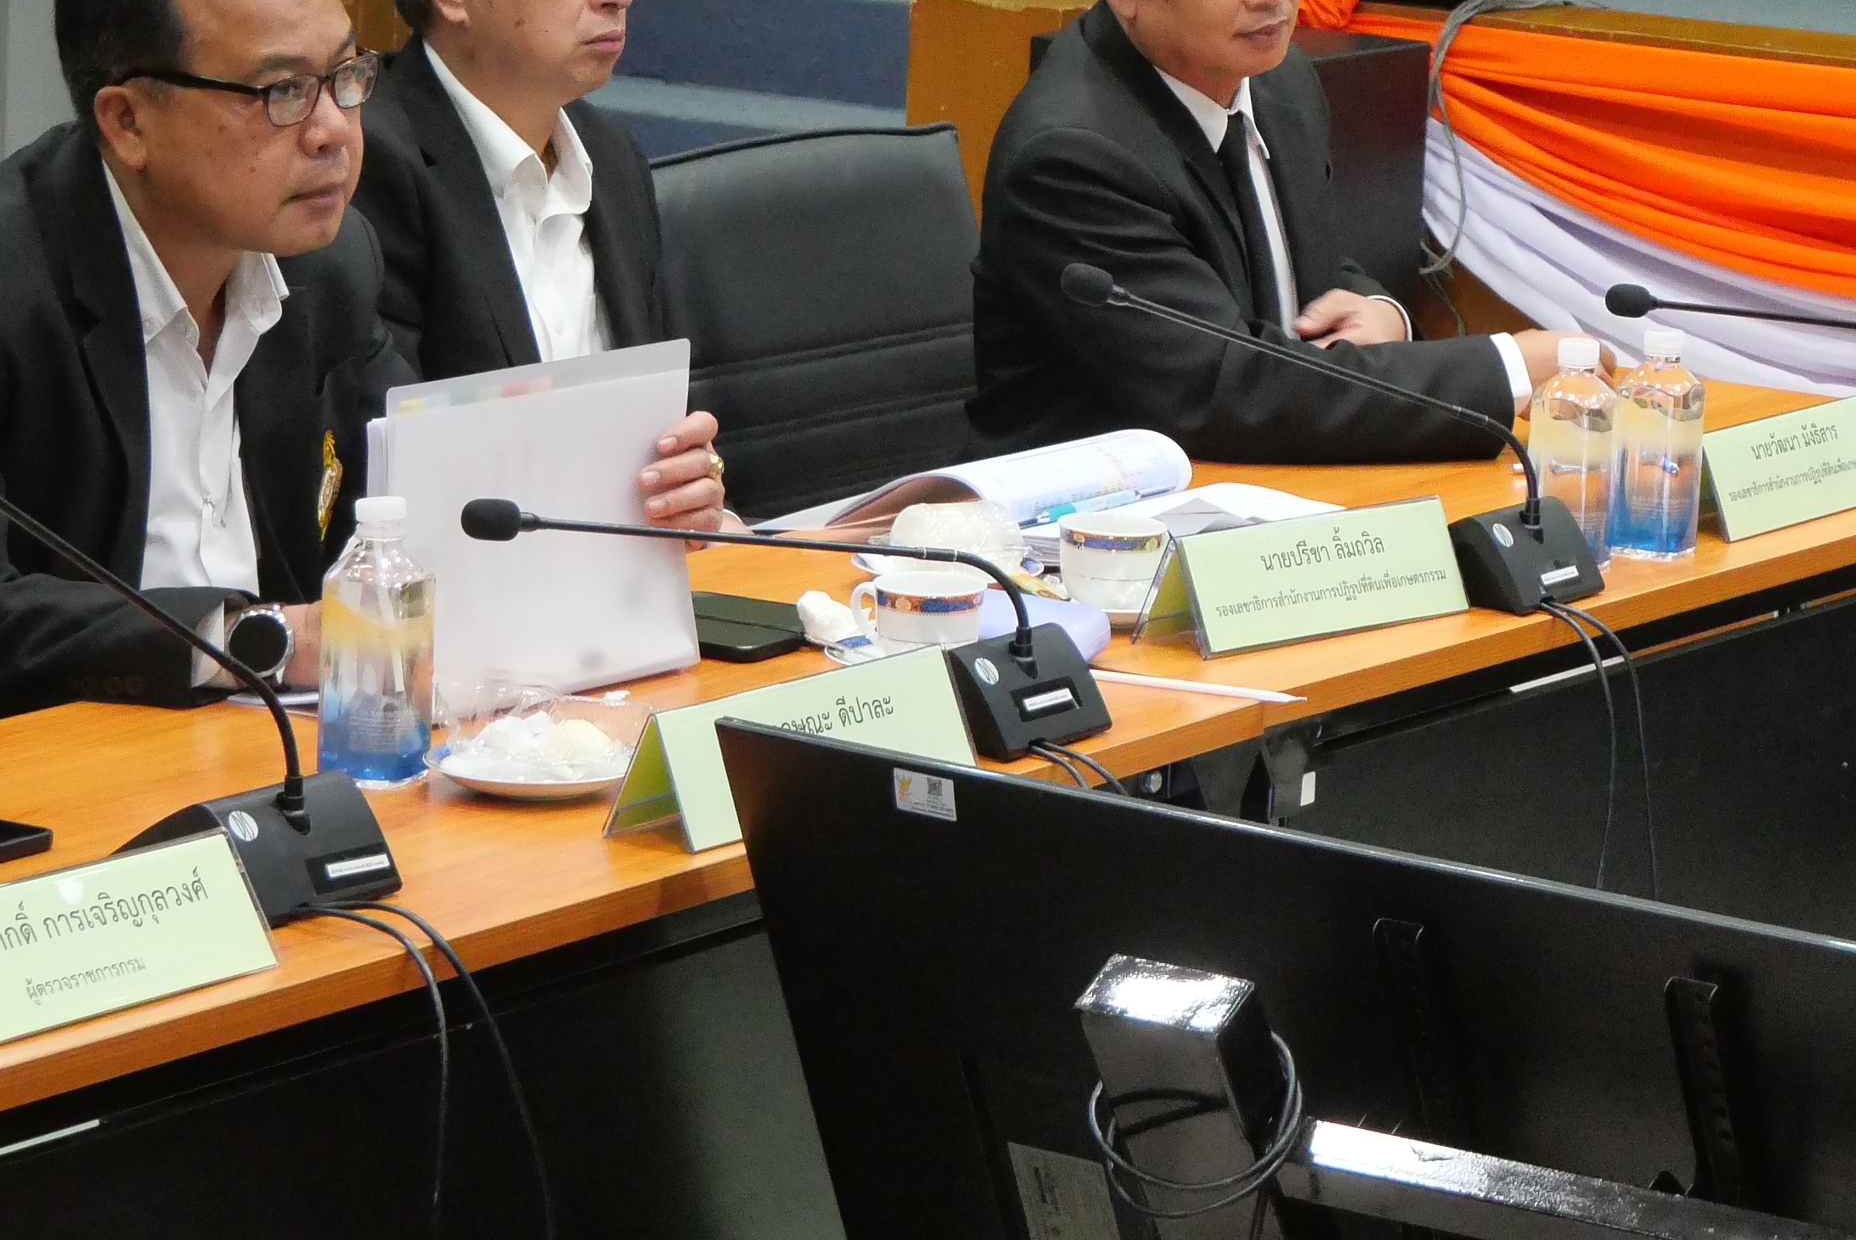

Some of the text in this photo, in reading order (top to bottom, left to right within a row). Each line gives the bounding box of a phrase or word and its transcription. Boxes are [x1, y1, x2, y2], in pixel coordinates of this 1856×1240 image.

[1260, 526, 1385, 571] นายปรีชา ลิ้มถวิล
[836, 696, 894, 728] ดีปาละ
[0, 866, 209, 950] กดิ์ การเจริญกุลวงศ์
[26, 956, 146, 1006] ผู้ตรวจราชการกรม
